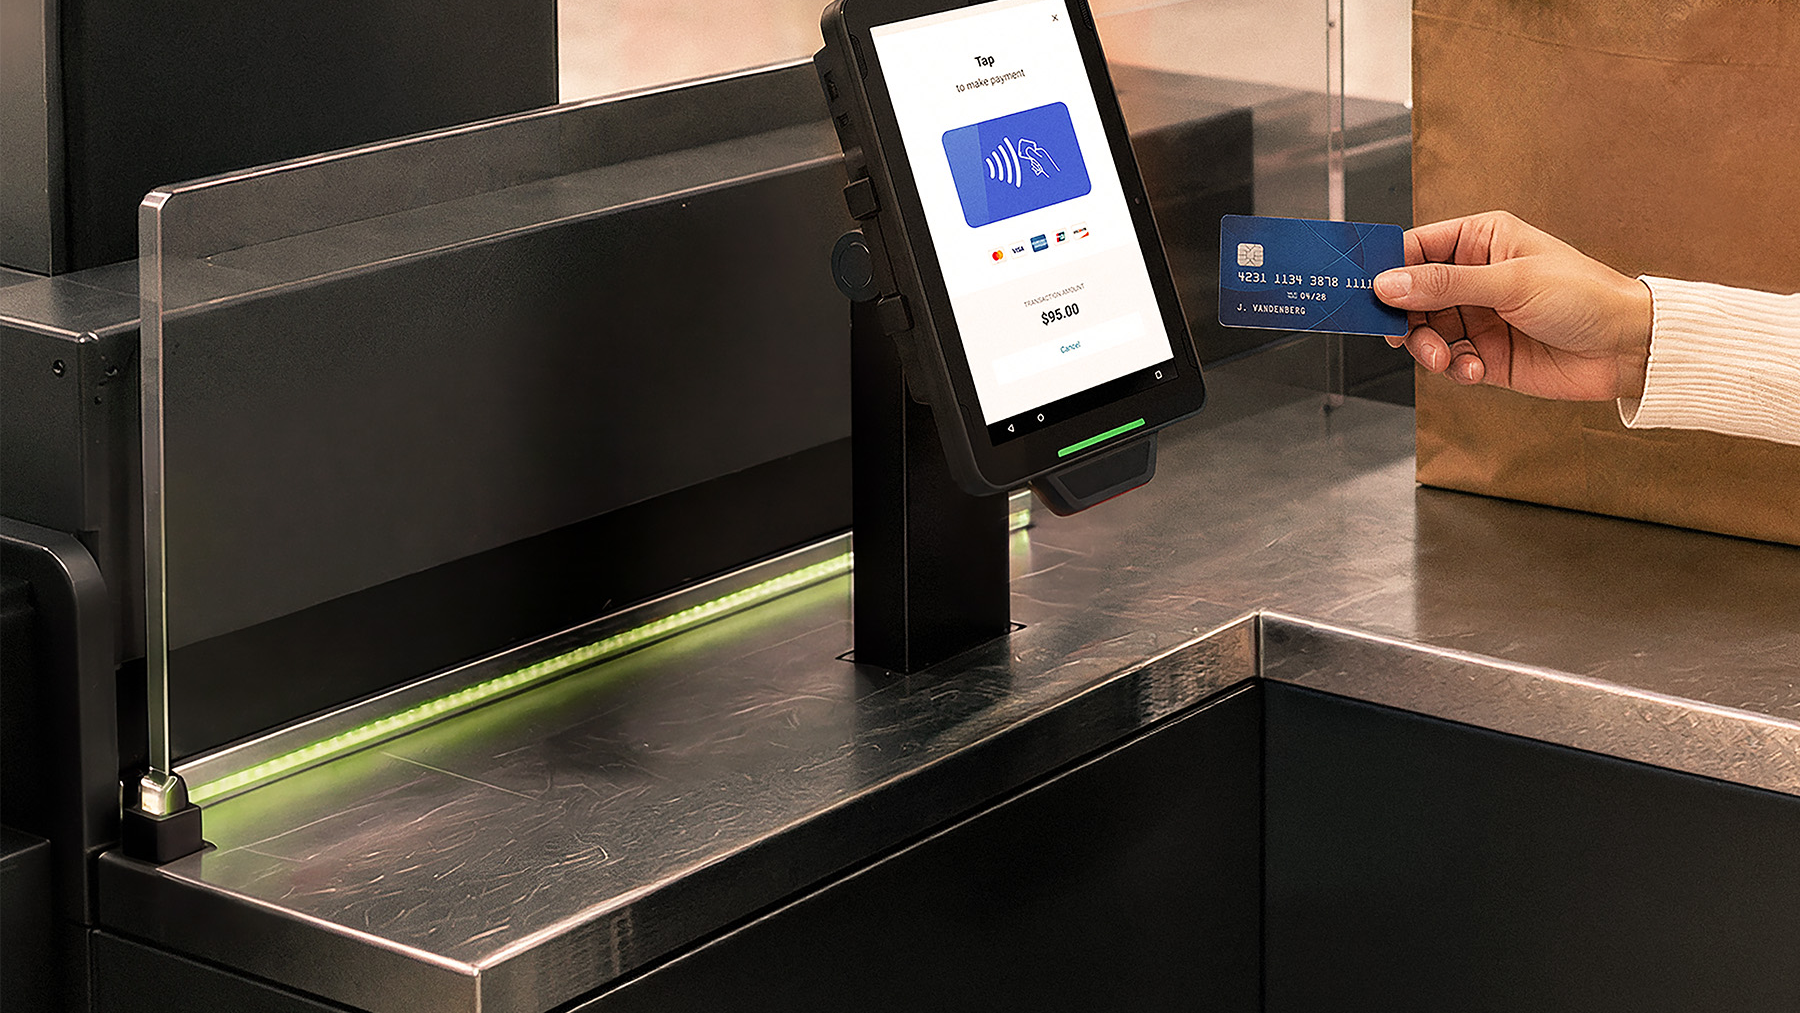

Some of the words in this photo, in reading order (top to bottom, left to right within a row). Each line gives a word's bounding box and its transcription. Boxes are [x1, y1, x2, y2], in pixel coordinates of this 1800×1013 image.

[974, 55, 995, 68] Tap
[955, 84, 966, 93] to
[966, 78, 989, 91] make
[989, 69, 1026, 87] payment
[1237, 271, 1267, 284] 4231
[1274, 273, 1303, 285] 1134
[1309, 275, 1339, 288] 3878
[1345, 277, 1373, 290] 1111
[1299, 291, 1327, 302] 04/28
[1041, 302, 1080, 326] $95.00
[1236, 303, 1247, 312] J.
[1252, 303, 1306, 316] VANDENBERG
